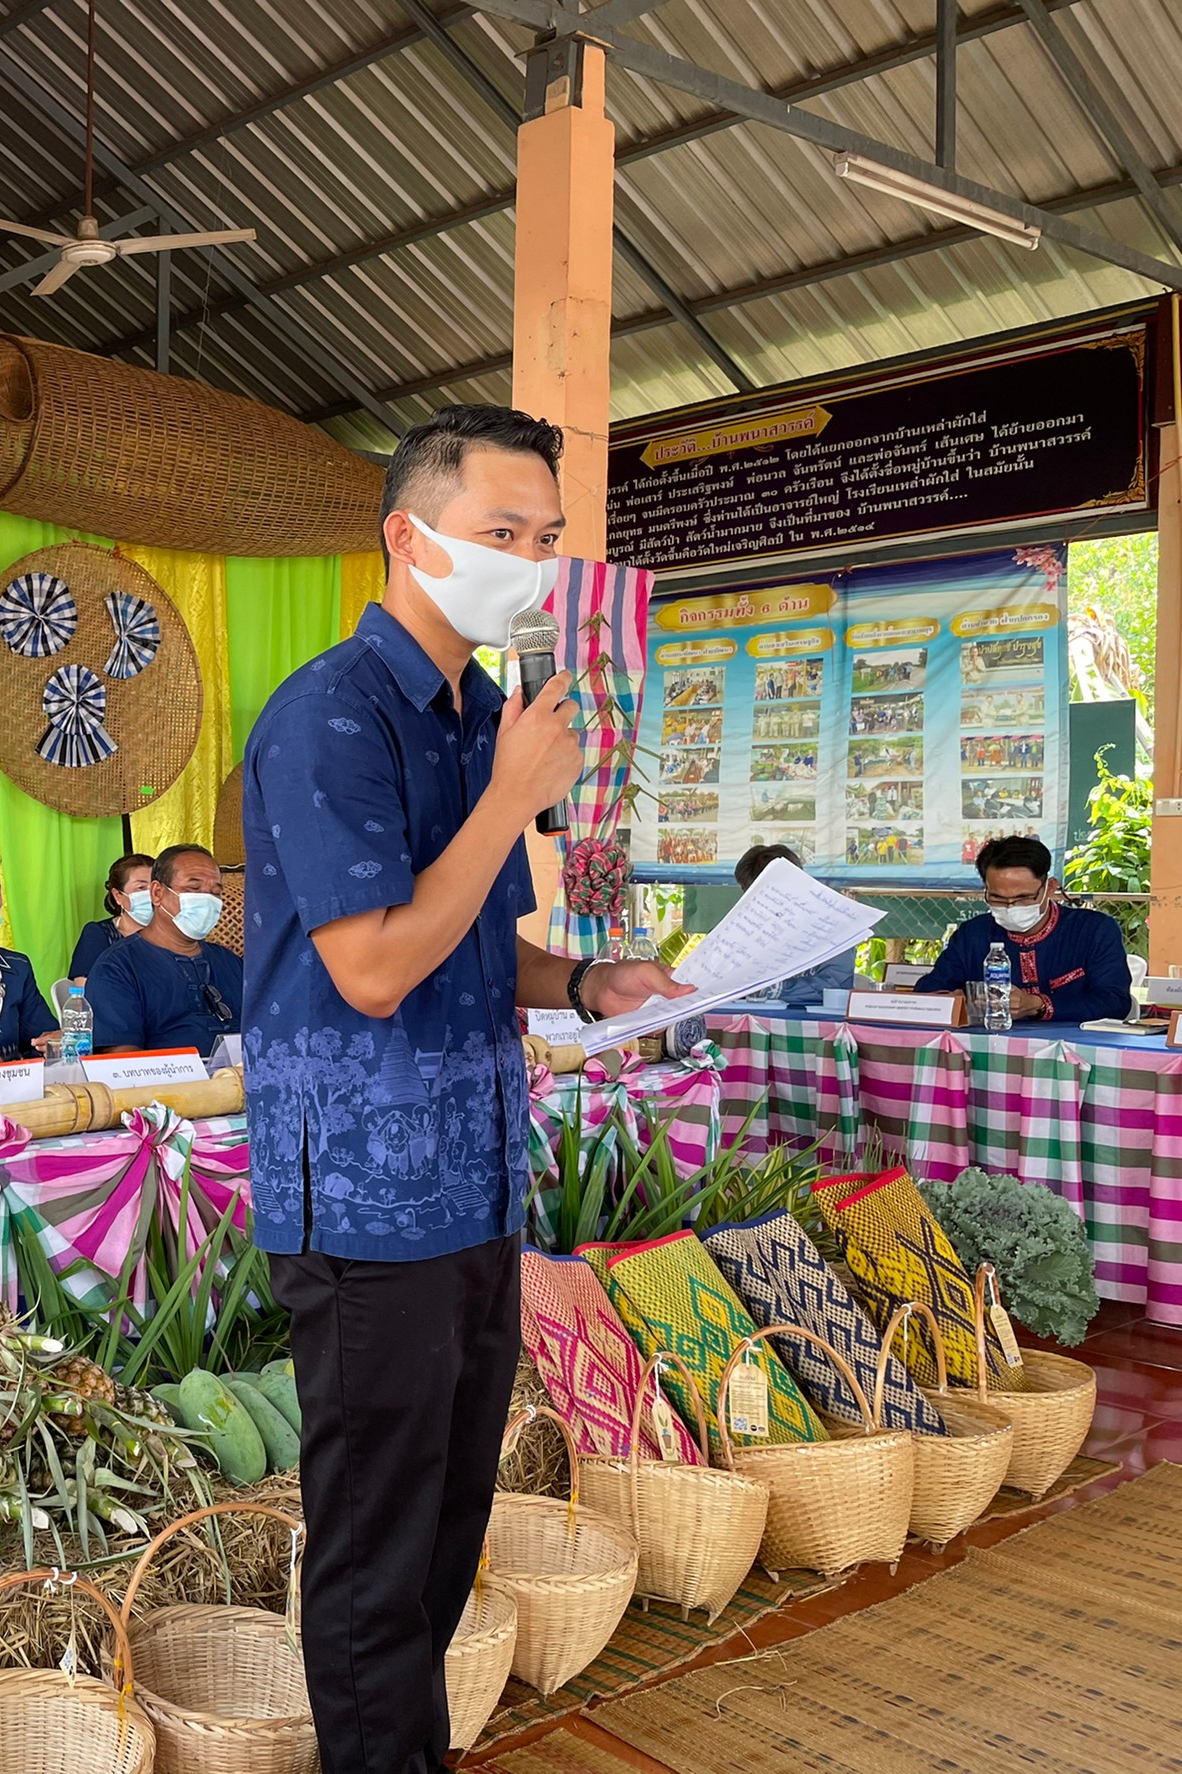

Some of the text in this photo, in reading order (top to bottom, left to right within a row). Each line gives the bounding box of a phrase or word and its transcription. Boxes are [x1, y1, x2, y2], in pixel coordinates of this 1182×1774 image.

[747, 470, 786, 484] พ่อนวล
[991, 413, 1084, 438] ได้ย้ายออกมา
[642, 492, 755, 518] จนมีครอบครัวประมาณ
[784, 477, 834, 494] ครัวเรือน
[989, 426, 1092, 457] บ้านพนาสวรรค์
[966, 454, 1034, 478] ในสมัยนั้น
[769, 508, 850, 528] จึงเป็นที่มาของ
[789, 530, 804, 542] ใน
[679, 595, 754, 624] กิจกรรมทั้ง
[778, 595, 809, 612] ด้าน
[123, 1063, 194, 1079] บทบาทของผู้นำการ
